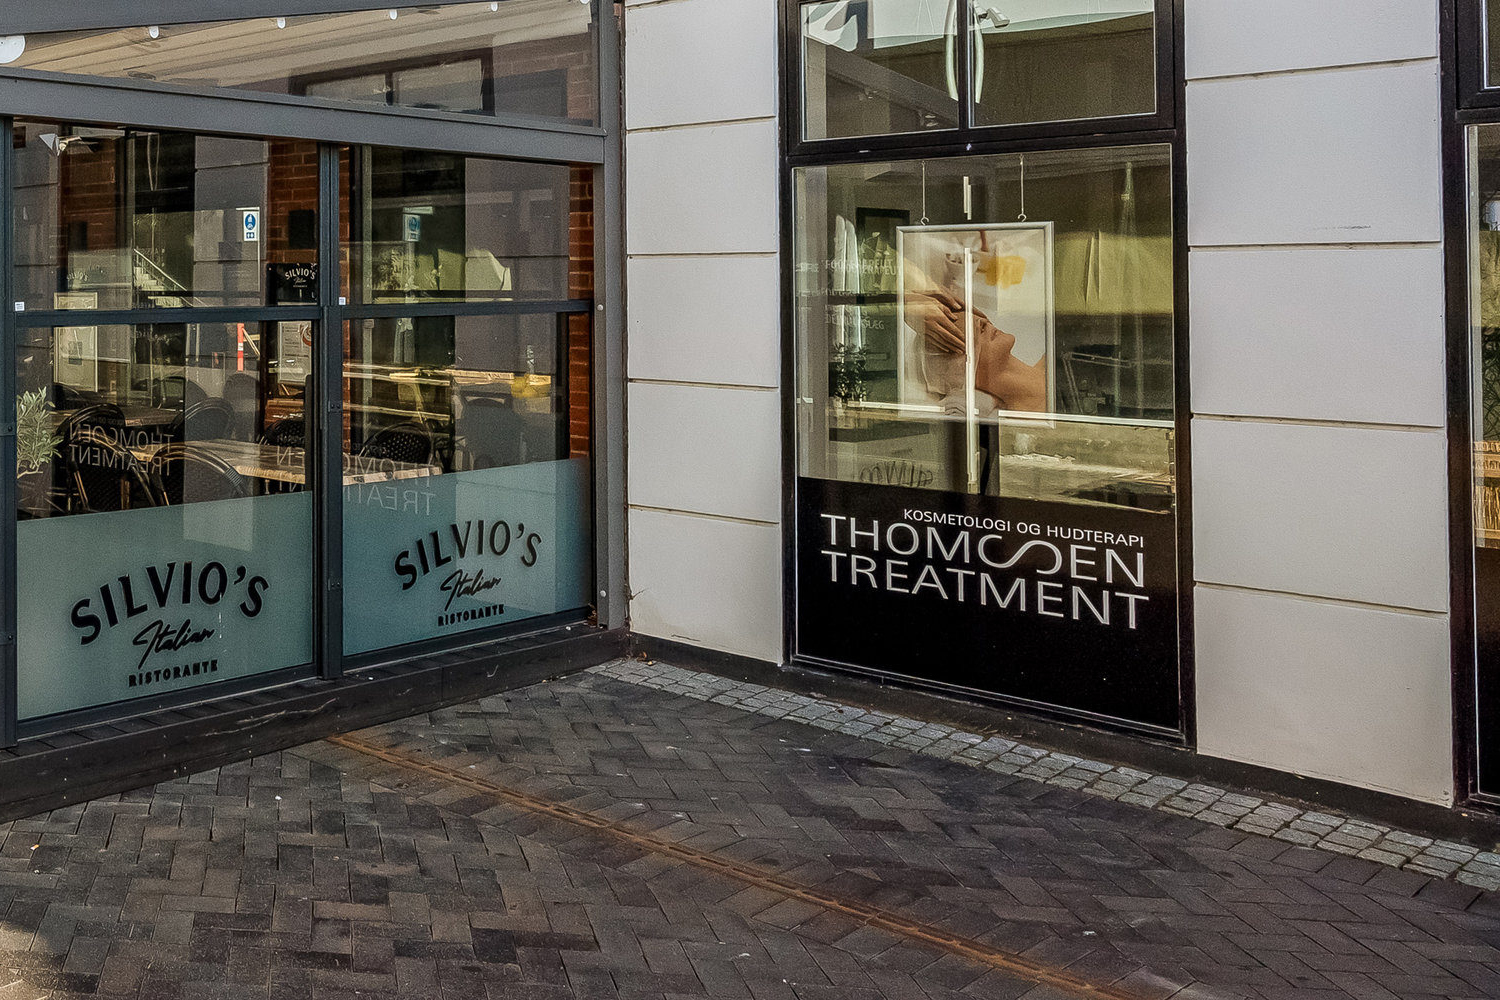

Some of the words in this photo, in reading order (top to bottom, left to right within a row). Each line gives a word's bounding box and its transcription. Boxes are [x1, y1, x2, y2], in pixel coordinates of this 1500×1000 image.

[903, 508, 1011, 533] KOSMETOLOGI
[1016, 522, 1041, 536] OG
[1046, 525, 1145, 549] HUDTERAPI
[394, 519, 542, 591] SILVIO'S
[70, 560, 270, 646] SILVIO'S
[439, 568, 502, 612] Italian
[820, 550, 1150, 630] TREATMENT
[437, 603, 505, 627] RISTORANTE
[132, 618, 215, 670] Italian
[128, 658, 218, 688] RISTORANTE
